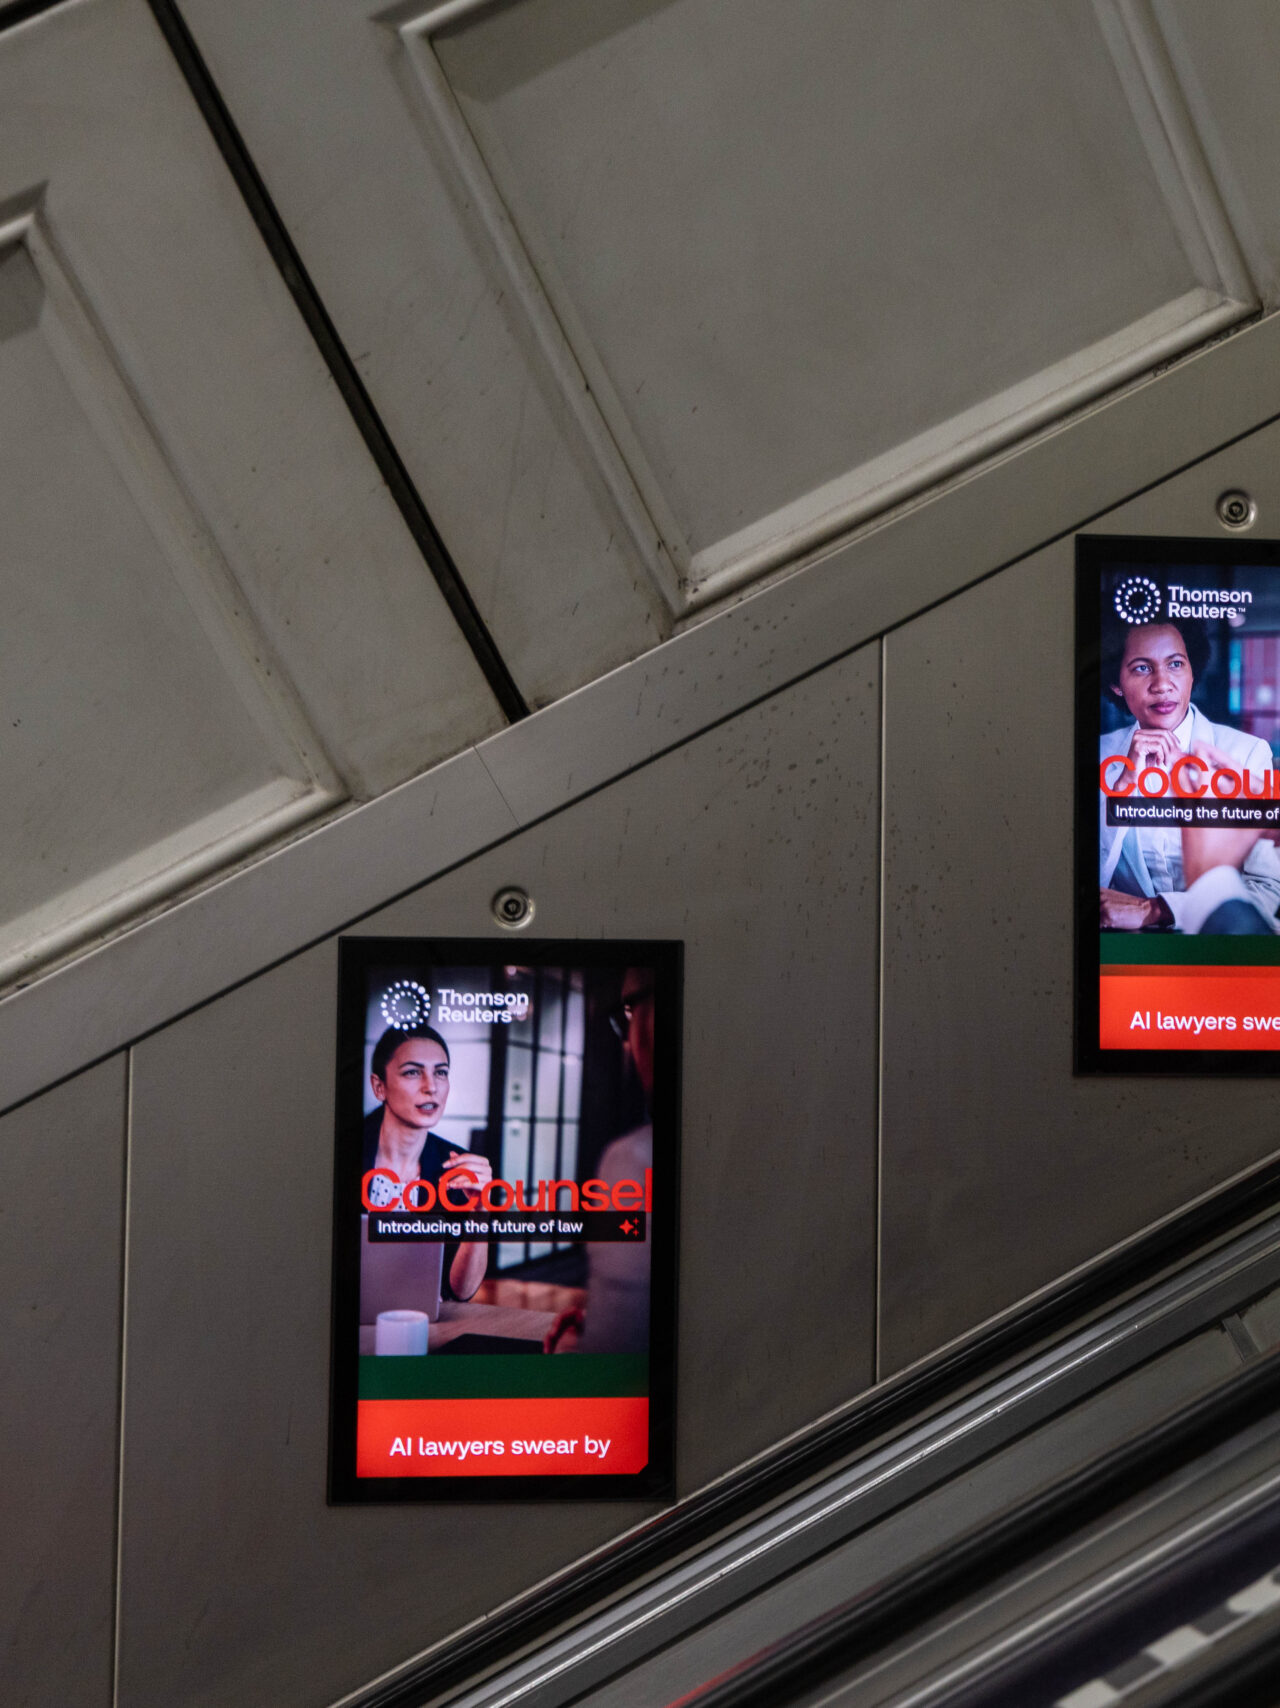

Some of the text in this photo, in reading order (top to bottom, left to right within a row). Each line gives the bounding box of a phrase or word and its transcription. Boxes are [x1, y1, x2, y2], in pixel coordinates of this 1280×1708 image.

[1167, 585, 1253, 604] Thomson
[1115, 804, 1193, 821] Introducing
[1196, 805, 1219, 819] the
[1221, 806, 1263, 820] future
[1265, 807, 1280, 821] of
[437, 988, 529, 1007] Thomson
[1129, 1011, 1150, 1030] AI
[1156, 1011, 1237, 1035] lawyers
[361, 1167, 653, 1213] CoCounsel
[377, 1218, 584, 1237] Introducing the future of law
[389, 1434, 612, 1461] AI lawyers swear by
